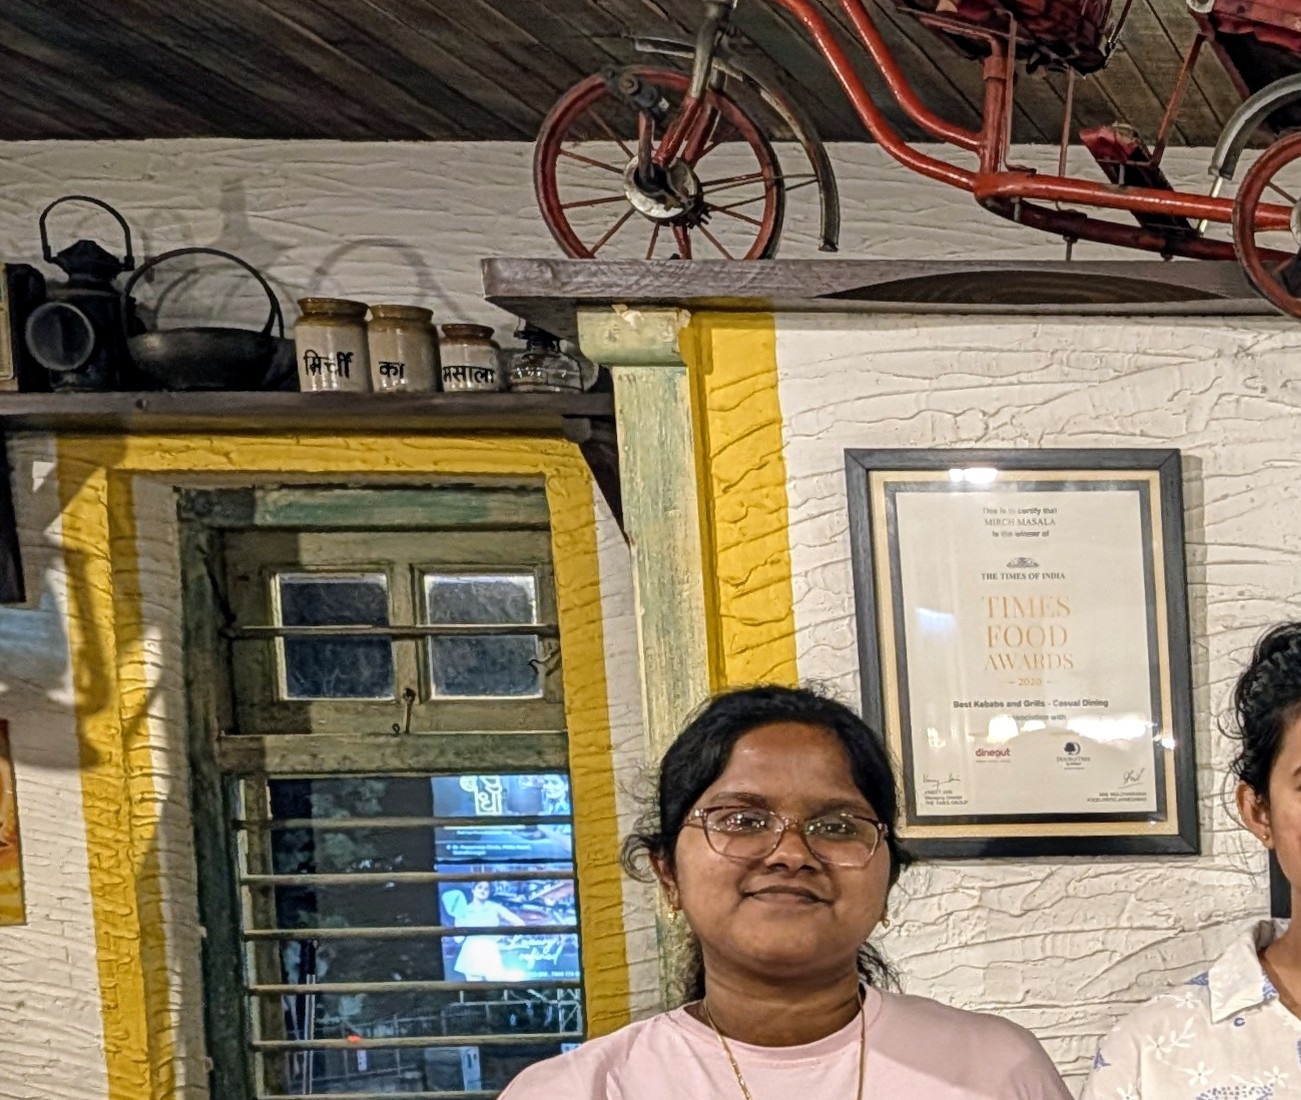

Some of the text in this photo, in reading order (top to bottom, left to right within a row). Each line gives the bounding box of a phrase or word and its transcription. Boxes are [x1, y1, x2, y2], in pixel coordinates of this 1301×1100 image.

[378, 361, 405, 379] का
[443, 365, 495, 384] मसाला
[985, 518, 1056, 526] MIRCH MASALA
[1000, 572, 1027, 580] TIMES
[1028, 572, 1040, 580] OF
[1042, 572, 1066, 580] INDIA
[982, 596, 1071, 619] TIMES
[987, 625, 1068, 648] FOOD
[985, 653, 1074, 671] AWARDS
[953, 700, 972, 709] Best
[973, 700, 1004, 708] Kebabs
[1006, 700, 1022, 708] and
[1024, 700, 1046, 708] Grills
[1053, 699, 1080, 707] Casual
[1082, 699, 1109, 708] Dining
